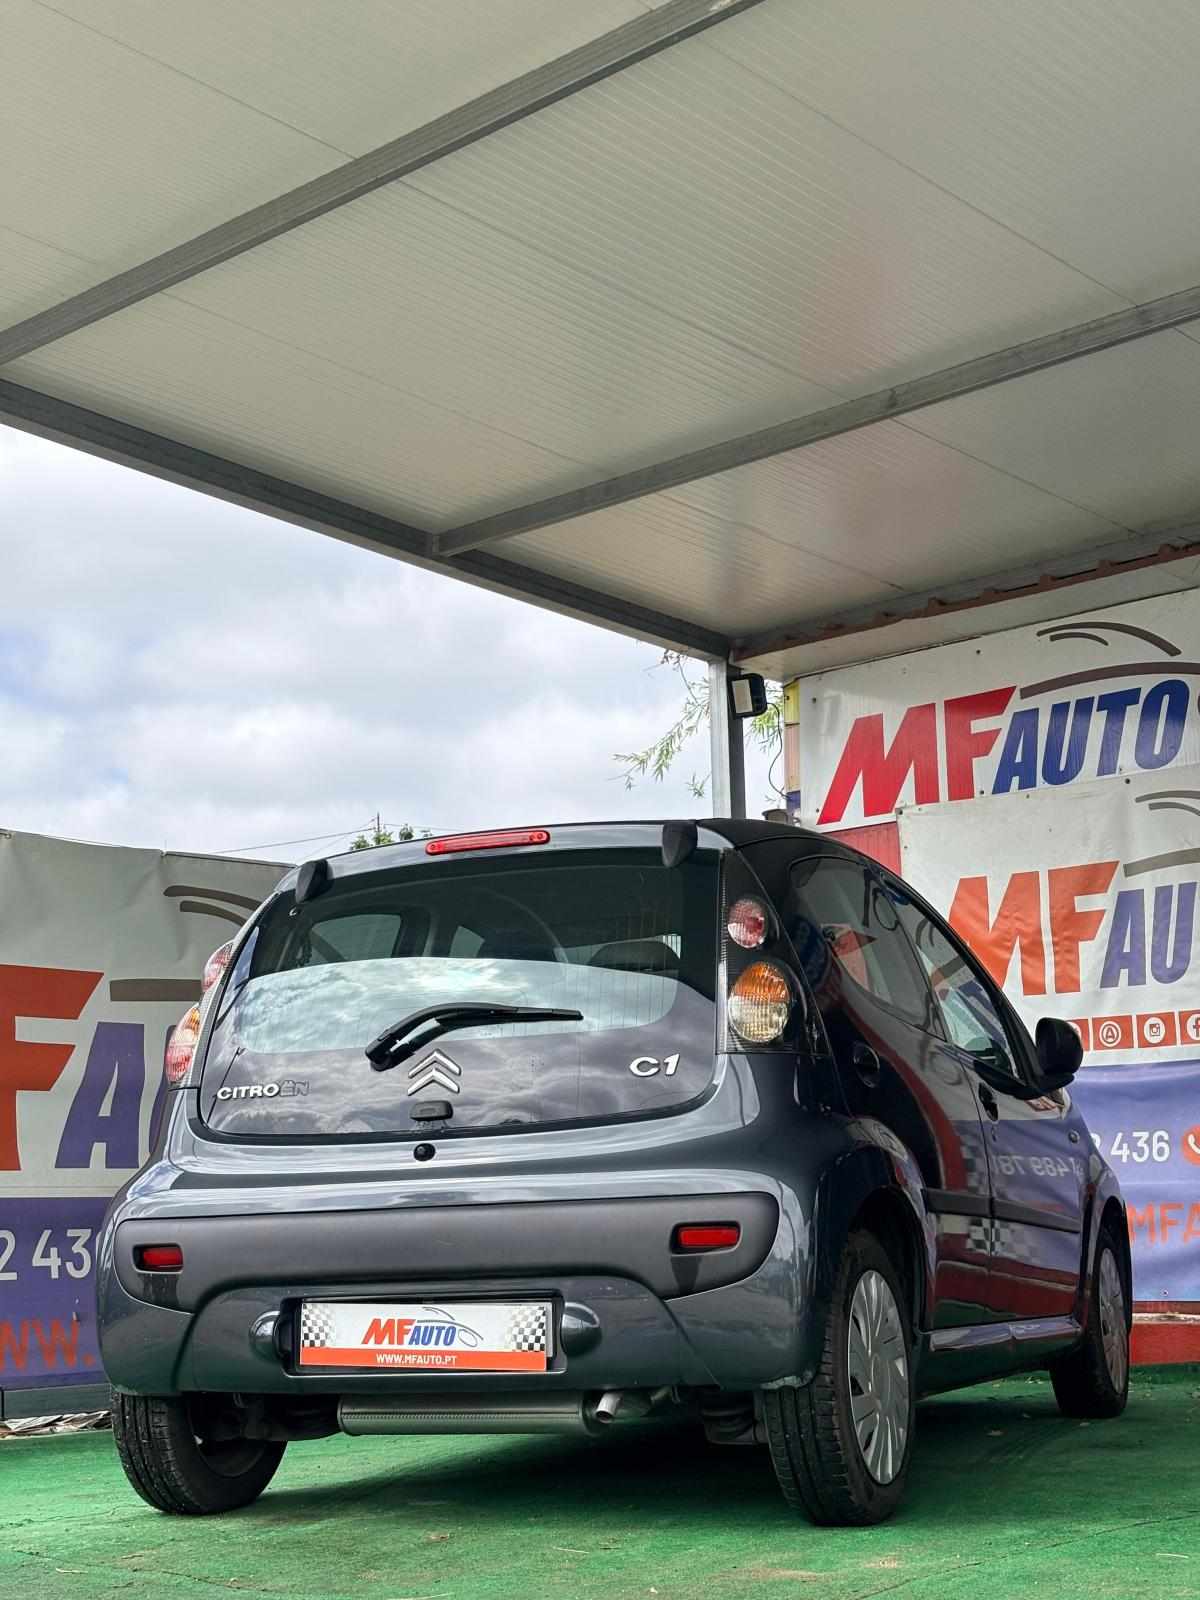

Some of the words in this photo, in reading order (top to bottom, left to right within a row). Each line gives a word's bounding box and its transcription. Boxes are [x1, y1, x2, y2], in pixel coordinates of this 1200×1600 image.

[816, 680, 1190, 825] MFAUTO
[0, 964, 178, 1171] FA
[629, 1053, 680, 1077] C1
[1110, 1130, 1170, 1163] 436
[32, 1228, 102, 1280] 43
[361, 1318, 456, 1346] MFAUTO
[376, 1352, 457, 1366] WWW.MFAUTO.PT
